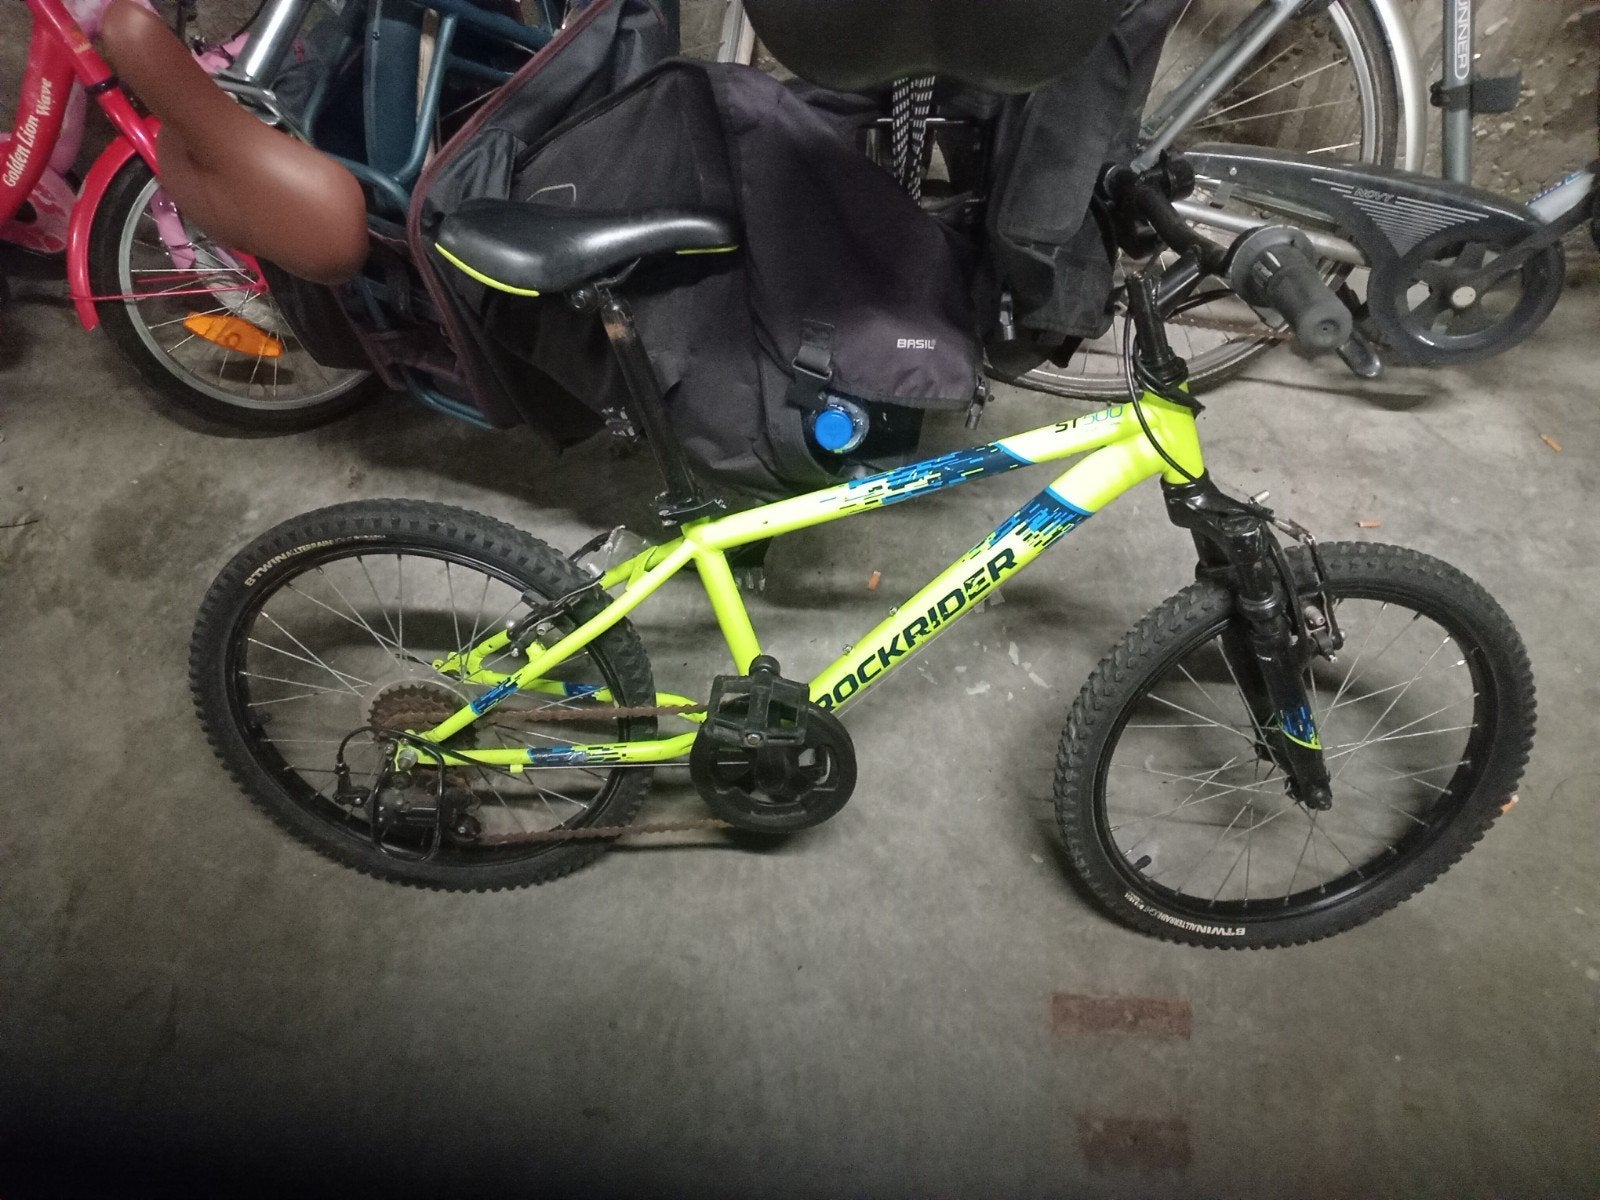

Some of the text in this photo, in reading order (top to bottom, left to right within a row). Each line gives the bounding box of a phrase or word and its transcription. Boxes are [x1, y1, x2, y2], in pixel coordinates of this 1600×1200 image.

[2, 77, 52, 187] Golden Lion Wave
[1354, 188, 1394, 203] NOVY
[897, 338, 935, 350] BASIL
[814, 547, 1018, 713] ROCKRIDER
